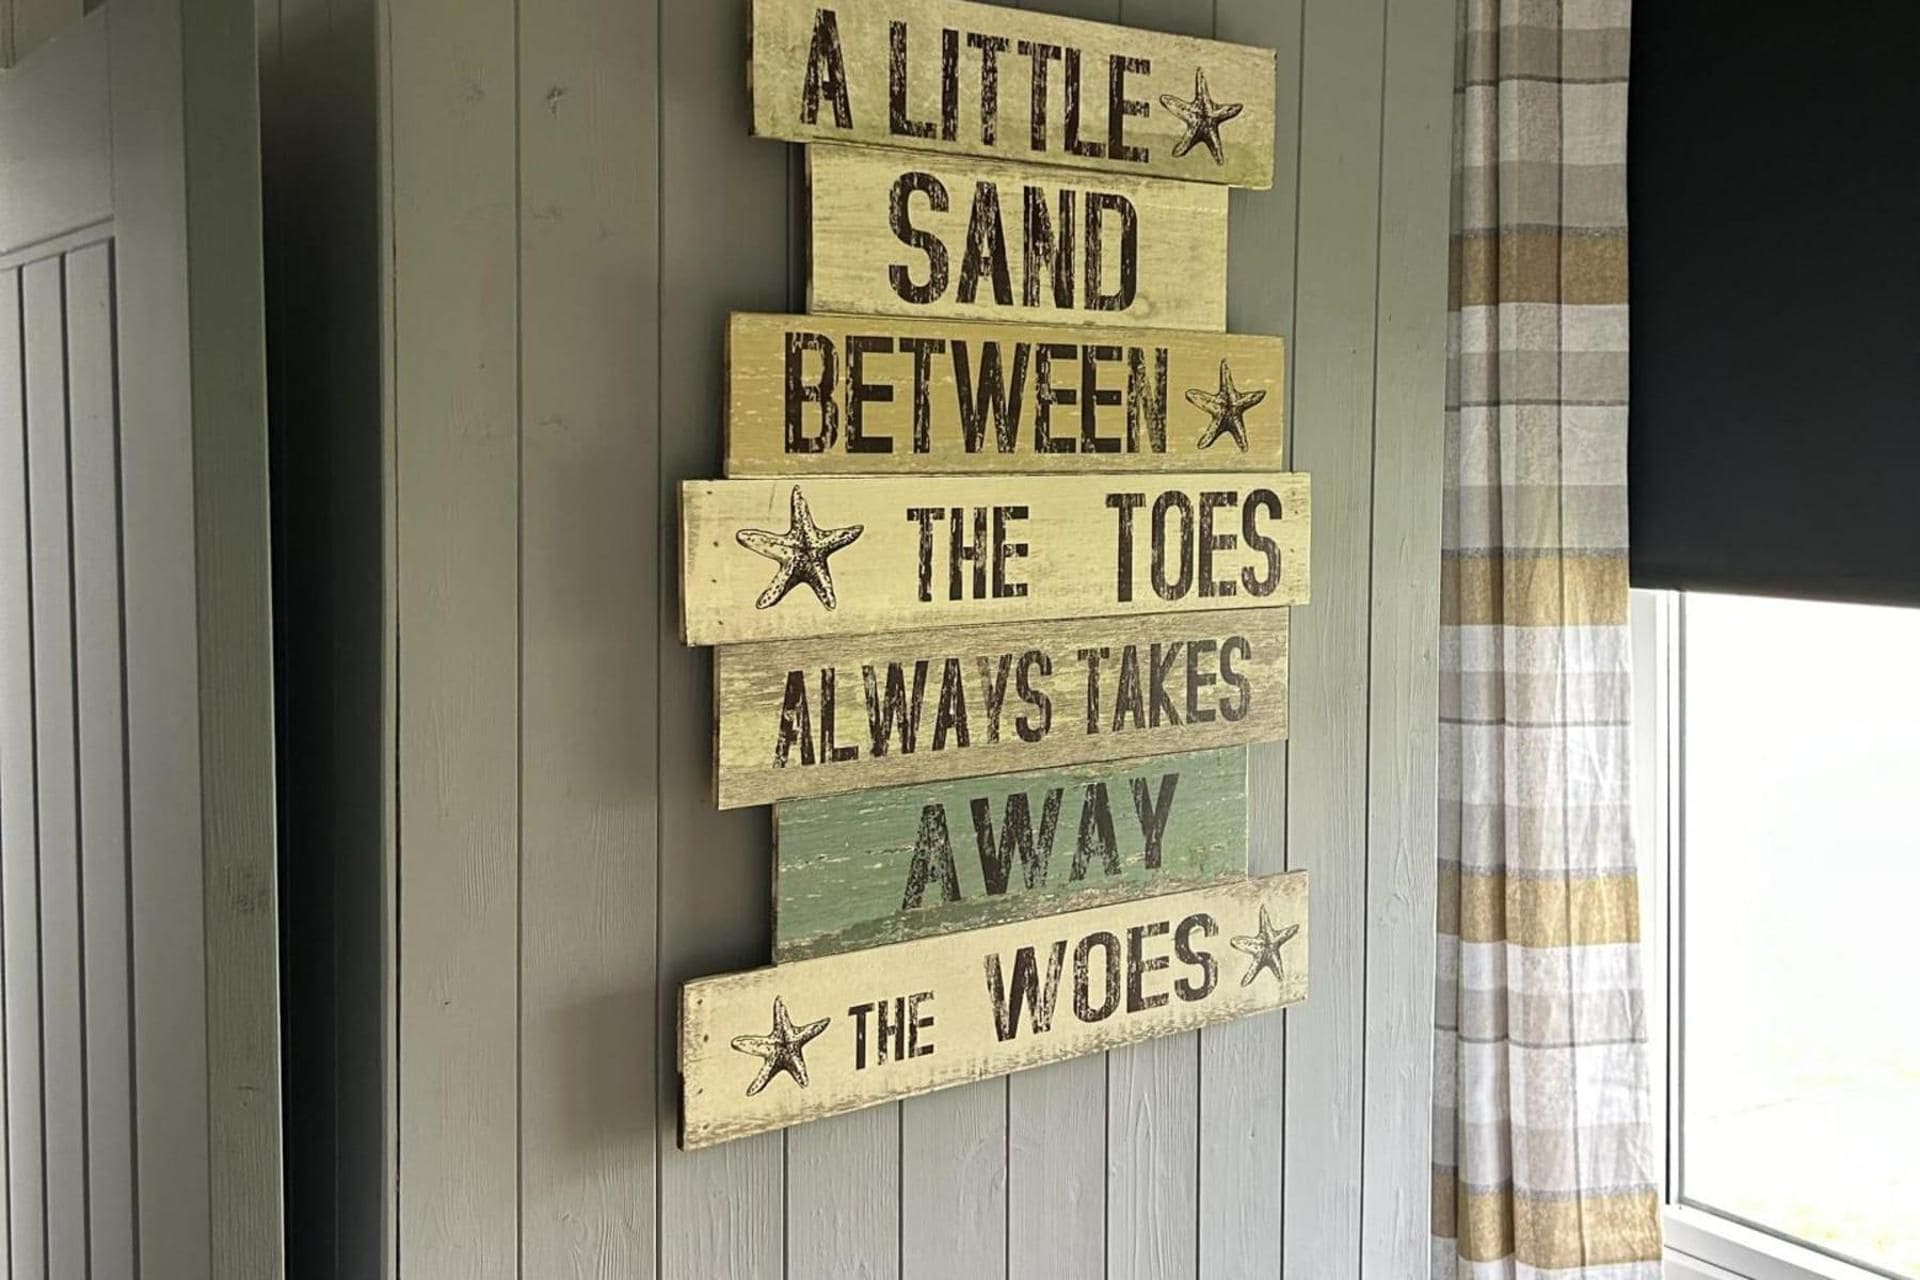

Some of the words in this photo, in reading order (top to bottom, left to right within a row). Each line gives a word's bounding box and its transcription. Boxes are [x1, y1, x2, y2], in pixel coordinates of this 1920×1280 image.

[800, 8, 852, 129] A
[889, 20, 1151, 163] LITTLE
[888, 171, 1138, 311] SAND
[784, 331, 1169, 454] BETWEEN
[906, 506, 1029, 602] THE
[1105, 490, 1282, 602] TOES
[773, 650, 1053, 769] ALWAYS
[1078, 636, 1252, 734] TAKES
[902, 773, 1179, 910] AWAY
[848, 992, 935, 1070] THE
[984, 913, 1219, 1042] WOES
